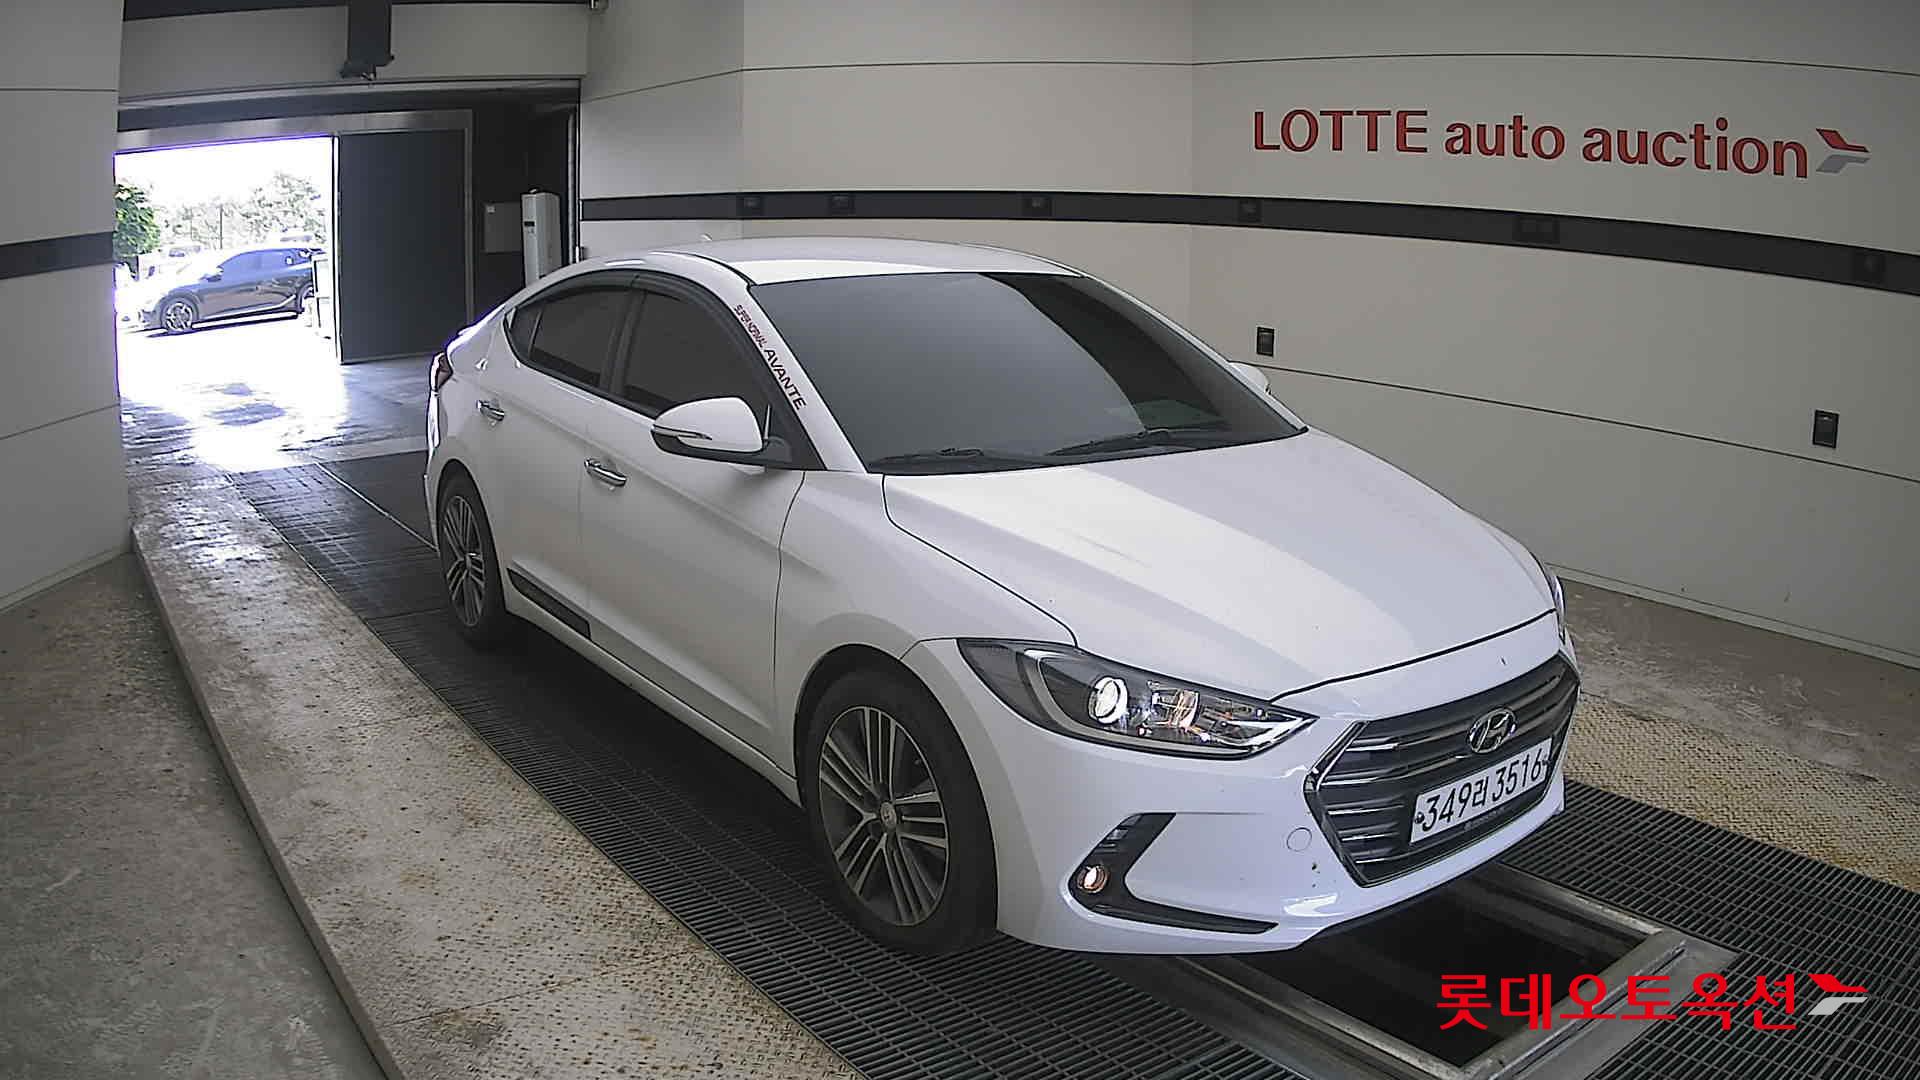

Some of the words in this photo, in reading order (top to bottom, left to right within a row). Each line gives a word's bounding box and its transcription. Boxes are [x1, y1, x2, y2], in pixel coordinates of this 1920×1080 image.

[1253, 110, 1428, 154] LOTTE
[1444, 114, 1566, 160] auto
[1582, 116, 1809, 179] auction
[764, 349, 807, 411] AVANTE
[1422, 776, 1489, 832] 349러
[1492, 748, 1543, 802] 3516
